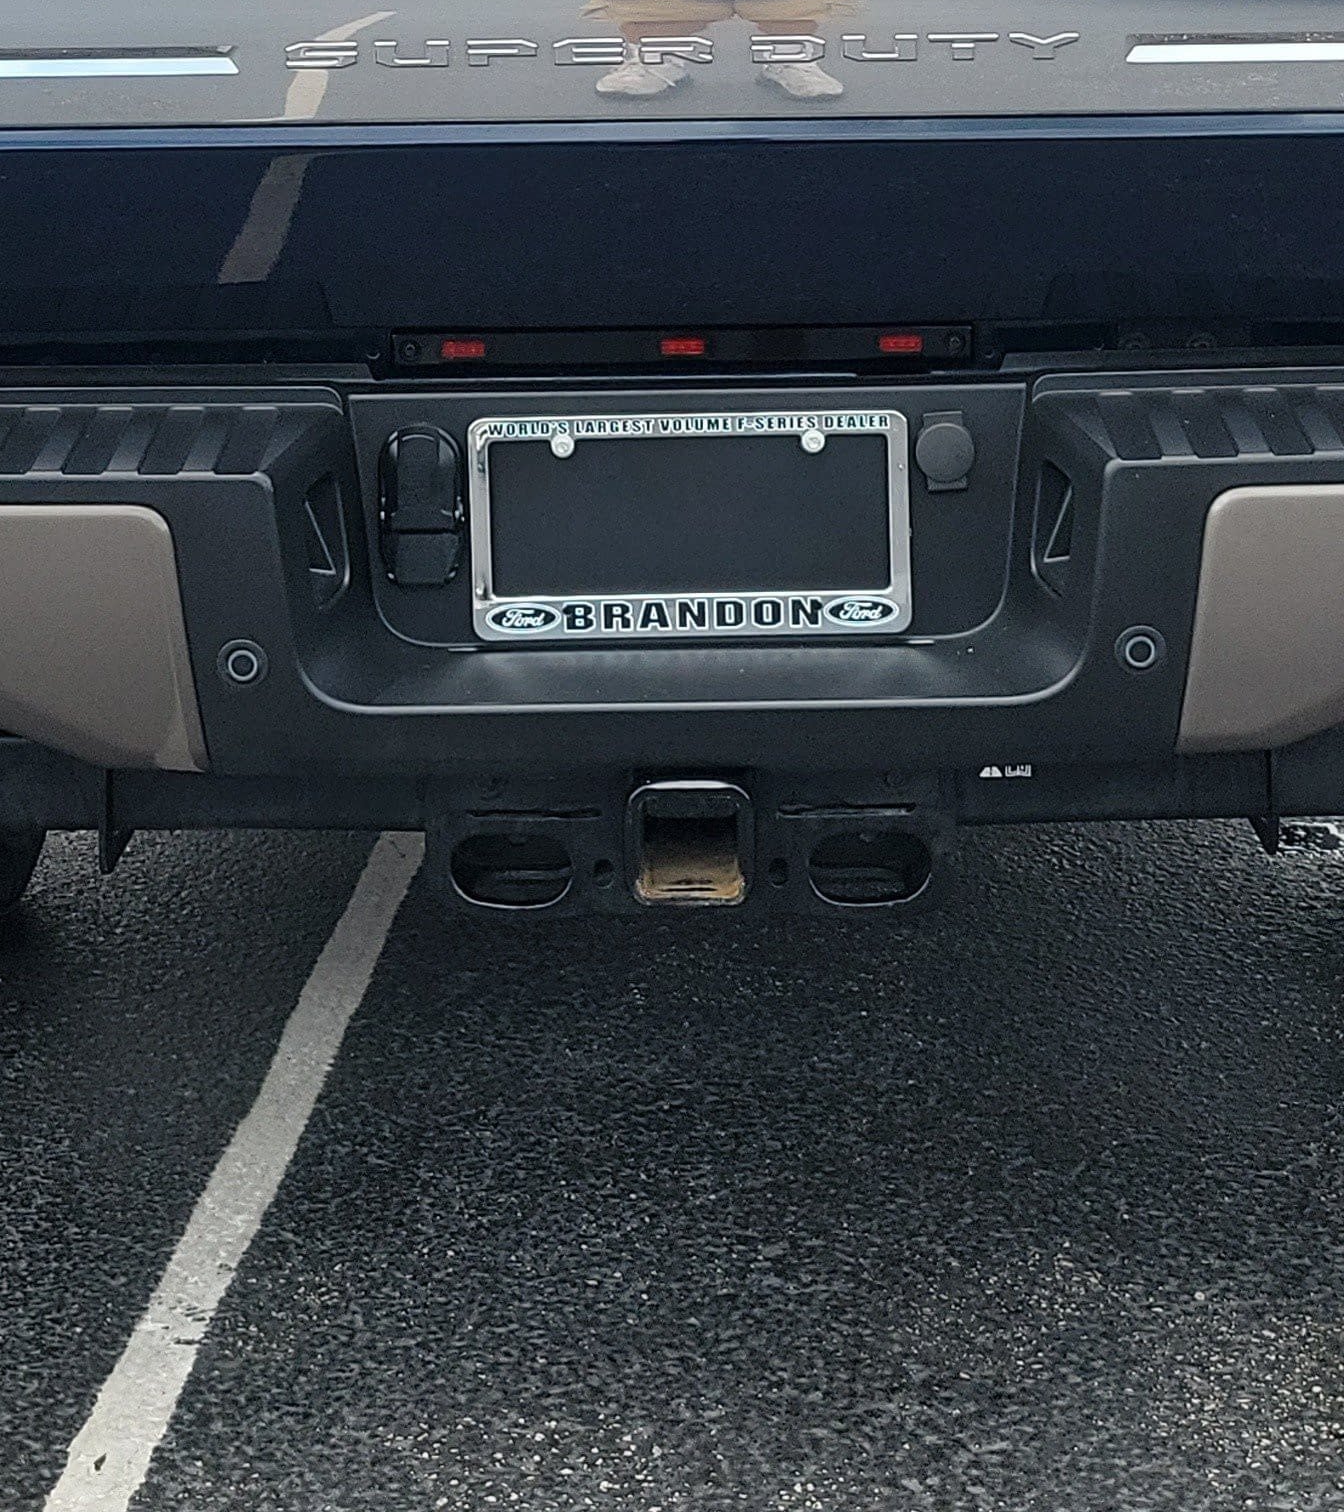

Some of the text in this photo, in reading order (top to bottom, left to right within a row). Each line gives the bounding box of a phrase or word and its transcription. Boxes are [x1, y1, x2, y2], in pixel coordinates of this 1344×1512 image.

[285, 31, 1080, 68] SUPER DUTY
[488, 413, 889, 436] WORLD'S LARGEST VOLUME F-SERIES DEALER
[500, 609, 546, 629] Ford
[563, 597, 823, 632] BRANDON
[839, 600, 885, 621] Ford
